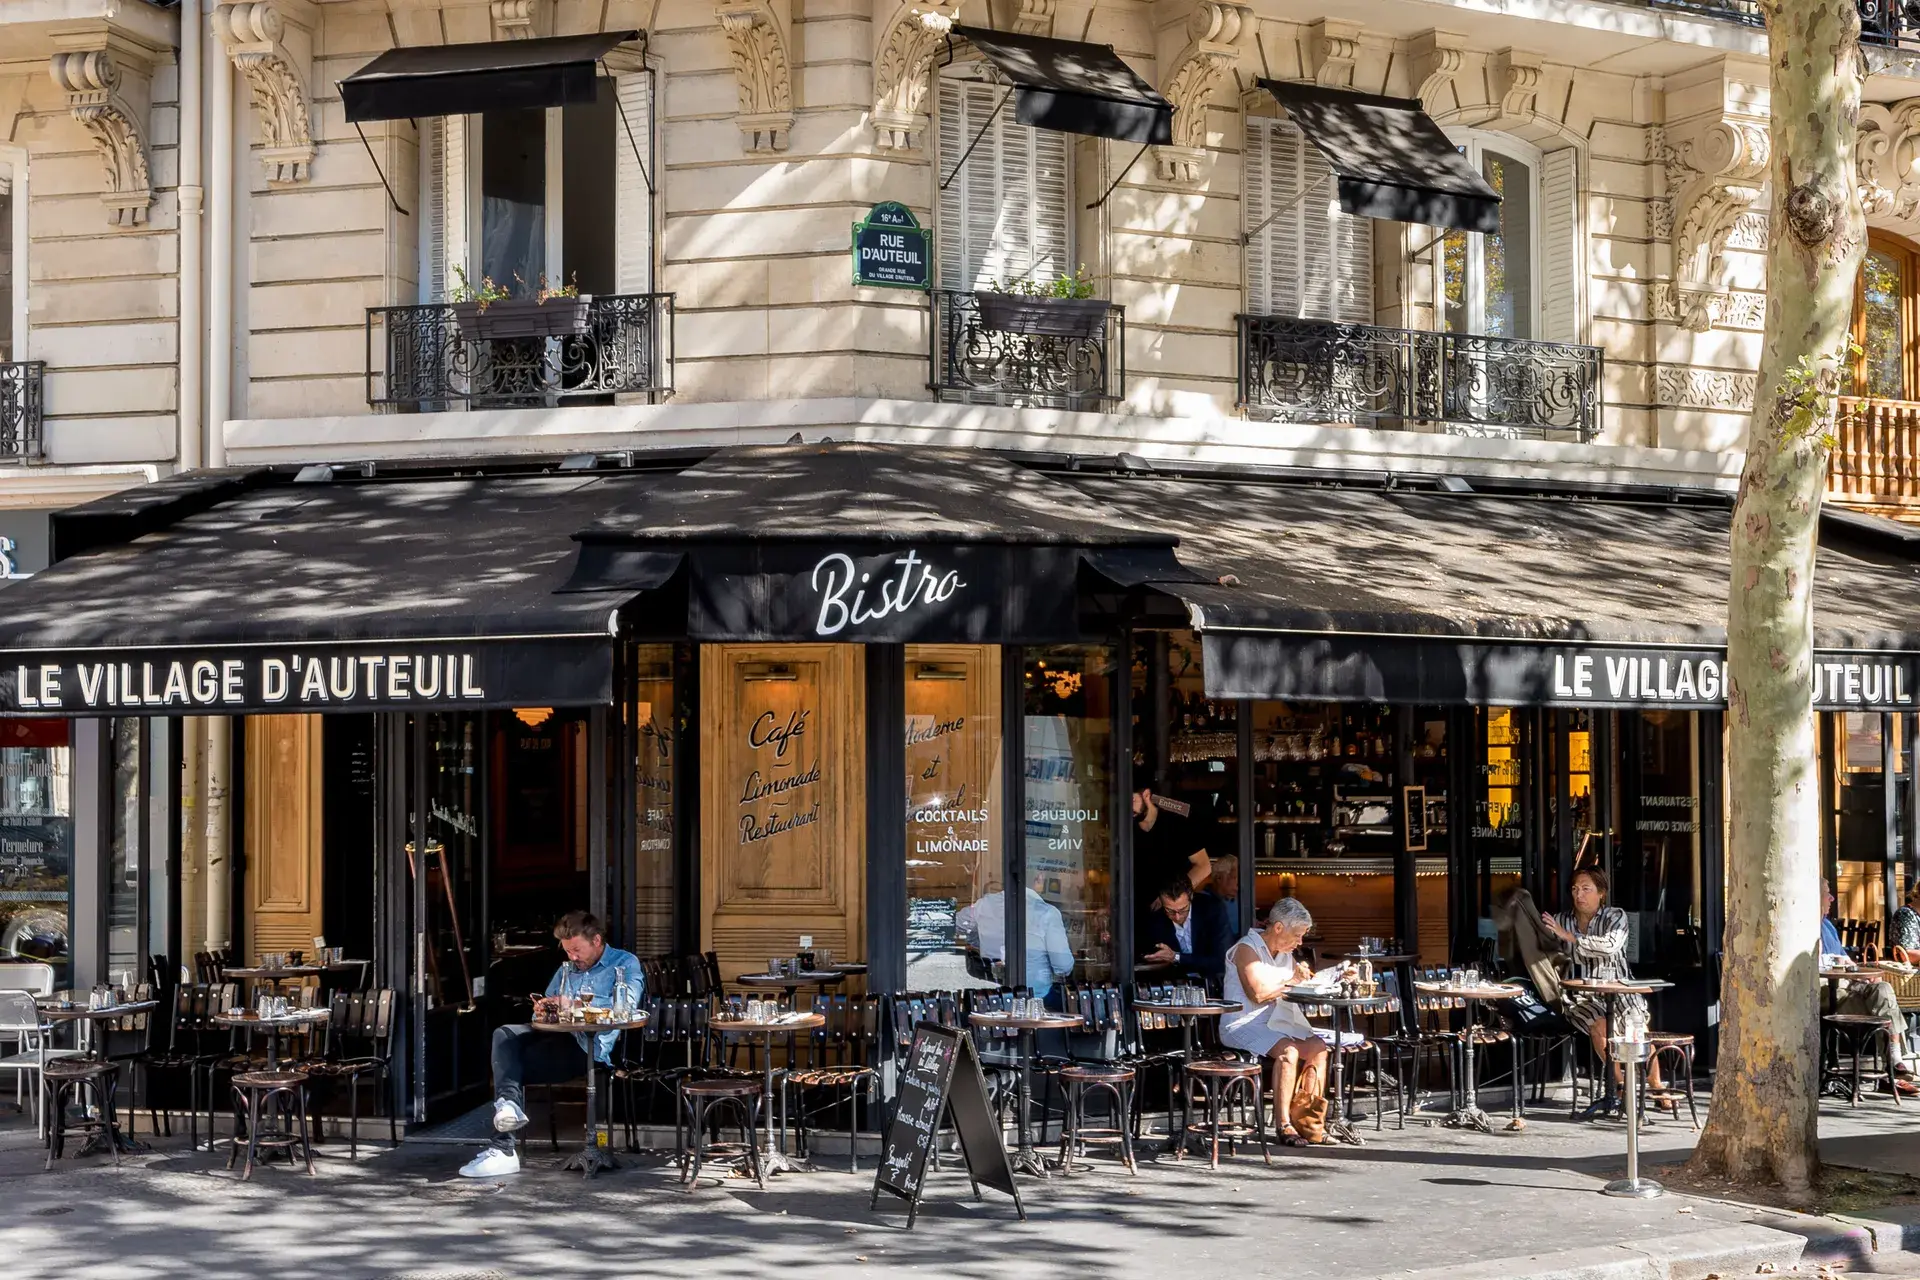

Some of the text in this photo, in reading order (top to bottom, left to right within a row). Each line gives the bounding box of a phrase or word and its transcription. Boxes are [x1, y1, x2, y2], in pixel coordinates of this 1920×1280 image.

[880, 234, 904, 248] RUE
[862, 247, 921, 264] D'AUTEUIL
[876, 272, 894, 280] VILLAGE
[812, 550, 967, 635] Bistro
[18, 654, 485, 707] LE VILLAGE D'AUTEUIL
[1554, 655, 1911, 703] LE VILLAG UTEUIL
[748, 710, 810, 759] Café
[921, 755, 941, 780] et
[739, 757, 820, 807] Limonade
[1159, 798, 1183, 811] Entrez
[739, 802, 820, 844] Restaurant
[915, 809, 988, 823] COCKTAILS
[947, 826, 954, 834] &
[2, 838, 44, 853] Fermeture
[916, 840, 989, 853] LIMONADE
